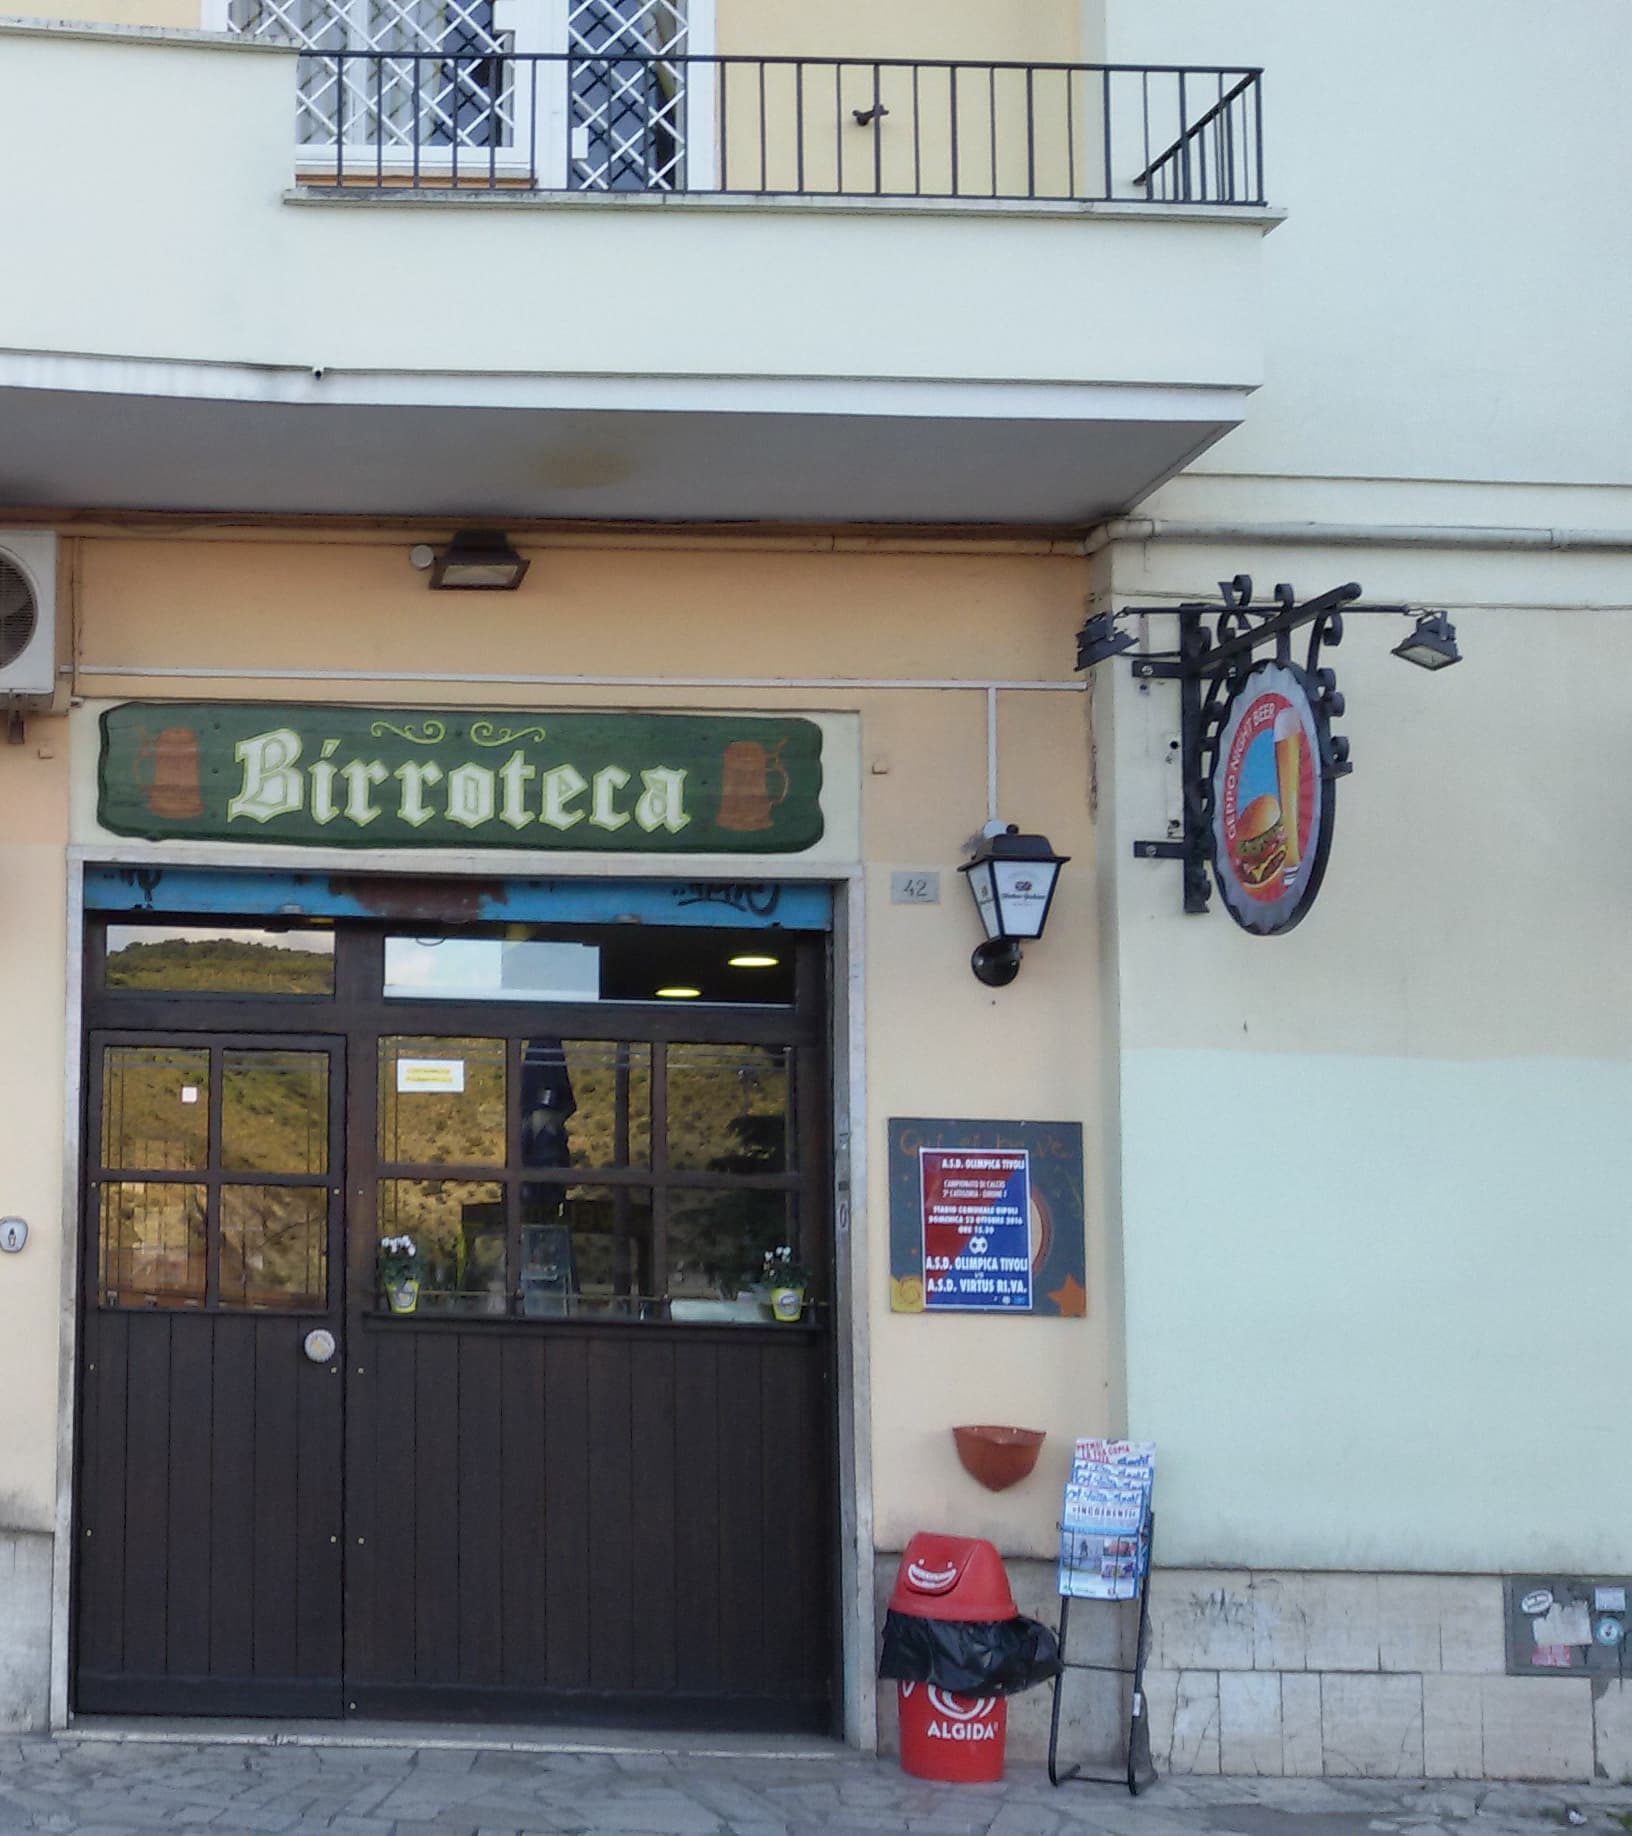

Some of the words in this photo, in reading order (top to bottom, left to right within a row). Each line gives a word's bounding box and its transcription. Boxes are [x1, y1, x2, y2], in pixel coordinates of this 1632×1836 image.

[1252, 702, 1275, 726] BEER
[227, 728, 692, 834] Birroteca
[904, 879, 928, 897] 42
[1002, 1160, 1025, 1170] TIVOLI
[926, 1256, 953, 1270] A.S.D.
[954, 1256, 999, 1271] OLIMPICA
[1000, 1257, 1028, 1271] TIVOLI
[927, 1278, 957, 1292] A.S.D.
[959, 1279, 995, 1293] VIRTUS
[927, 1721, 995, 1741] ALGIDA
